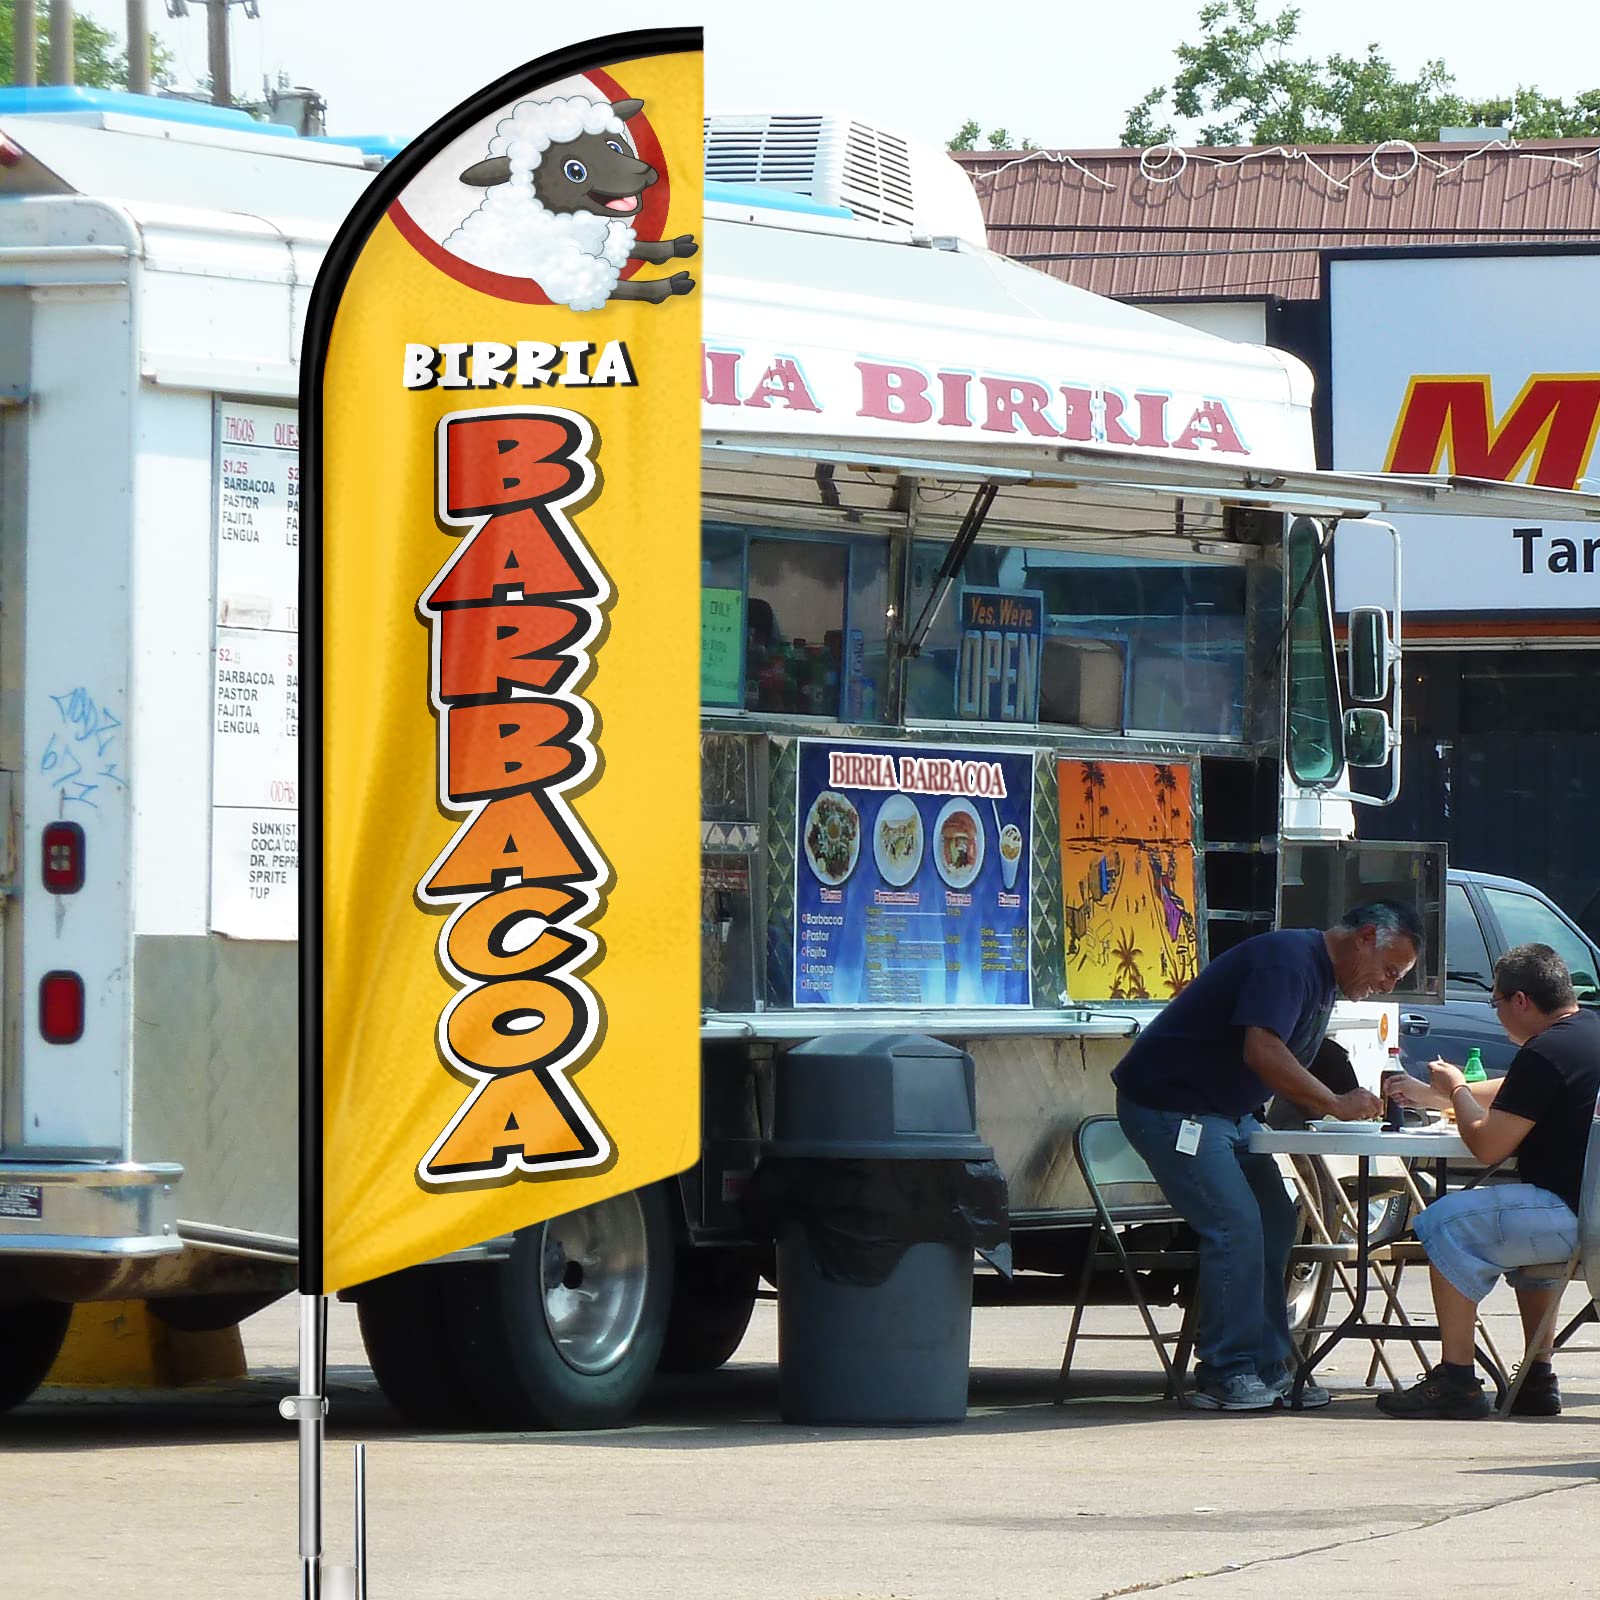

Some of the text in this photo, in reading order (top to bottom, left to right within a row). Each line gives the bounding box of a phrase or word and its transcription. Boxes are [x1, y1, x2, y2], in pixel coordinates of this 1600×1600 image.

[402, 340, 638, 390] BIRRIA
[700, 340, 1251, 456] IA BIRRIA
[223, 476, 276, 494] BARBACOA
[222, 494, 260, 509] PASTOR
[222, 511, 254, 526] FAJITA
[221, 527, 260, 543] LENGUA
[219, 669, 275, 686] BARBACOA
[960, 629, 1039, 721] OPEN
[218, 687, 258, 701] PASTOR
[218, 703, 252, 717] FAJITA
[286, 707, 298, 720] FA
[217, 719, 260, 735] LENGUA
[830, 753, 1005, 797] BIRRIA BARBACOA
[415, 405, 618, 1188] BARBACOA
[251, 821, 297, 836] SUNKIST
[284, 839, 299, 852] CO
[250, 854, 268, 867] DR.
[249, 870, 287, 884] SPRITE
[249, 886, 270, 900] 7UP
